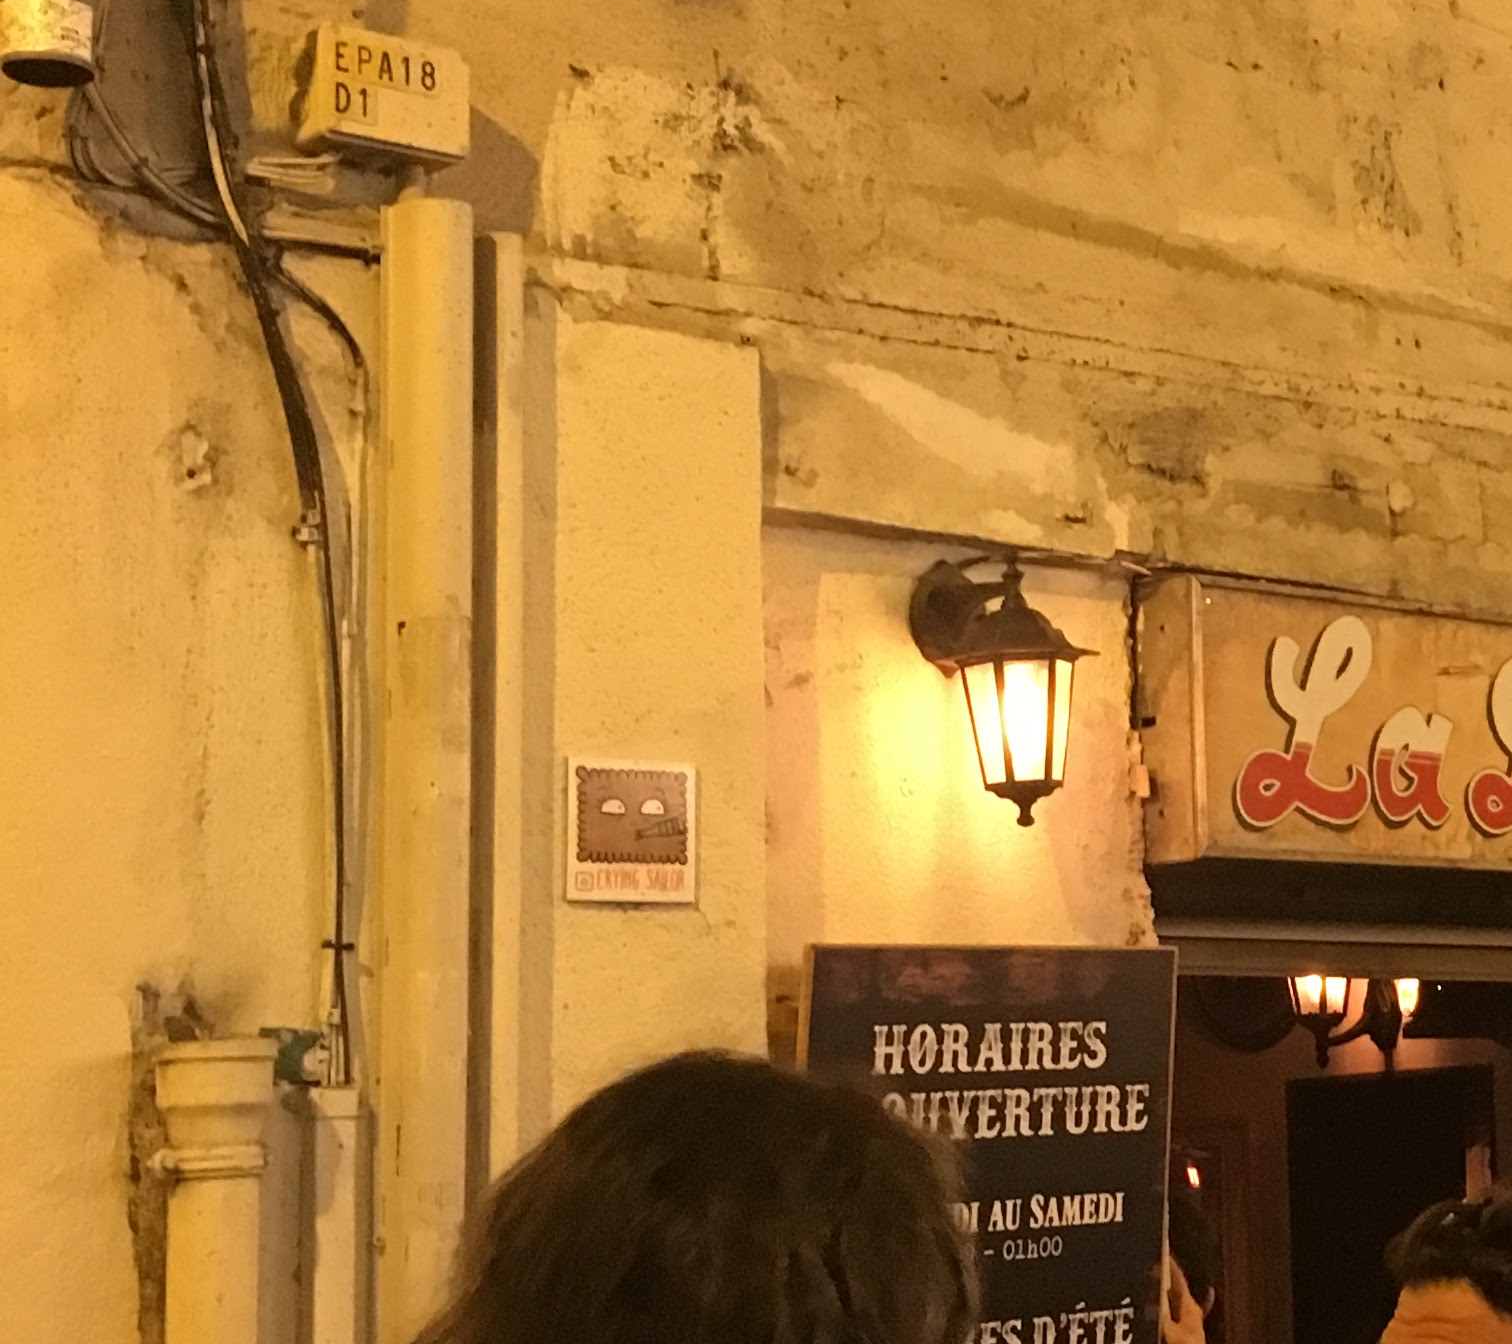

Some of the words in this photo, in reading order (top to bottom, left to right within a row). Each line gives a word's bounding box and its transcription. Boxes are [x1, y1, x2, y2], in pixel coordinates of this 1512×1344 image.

[335, 41, 436, 92] EPA18
[335, 81, 368, 118] D1
[1236, 614, 1456, 830] La
[872, 1020, 1108, 1076] HORAIRES
[881, 1083, 1150, 1140] OUVERTURE
[987, 1198, 1022, 1232] AU
[1029, 1192, 1125, 1230] SAMEDI
[1002, 1235, 1063, 1261] 01h00
